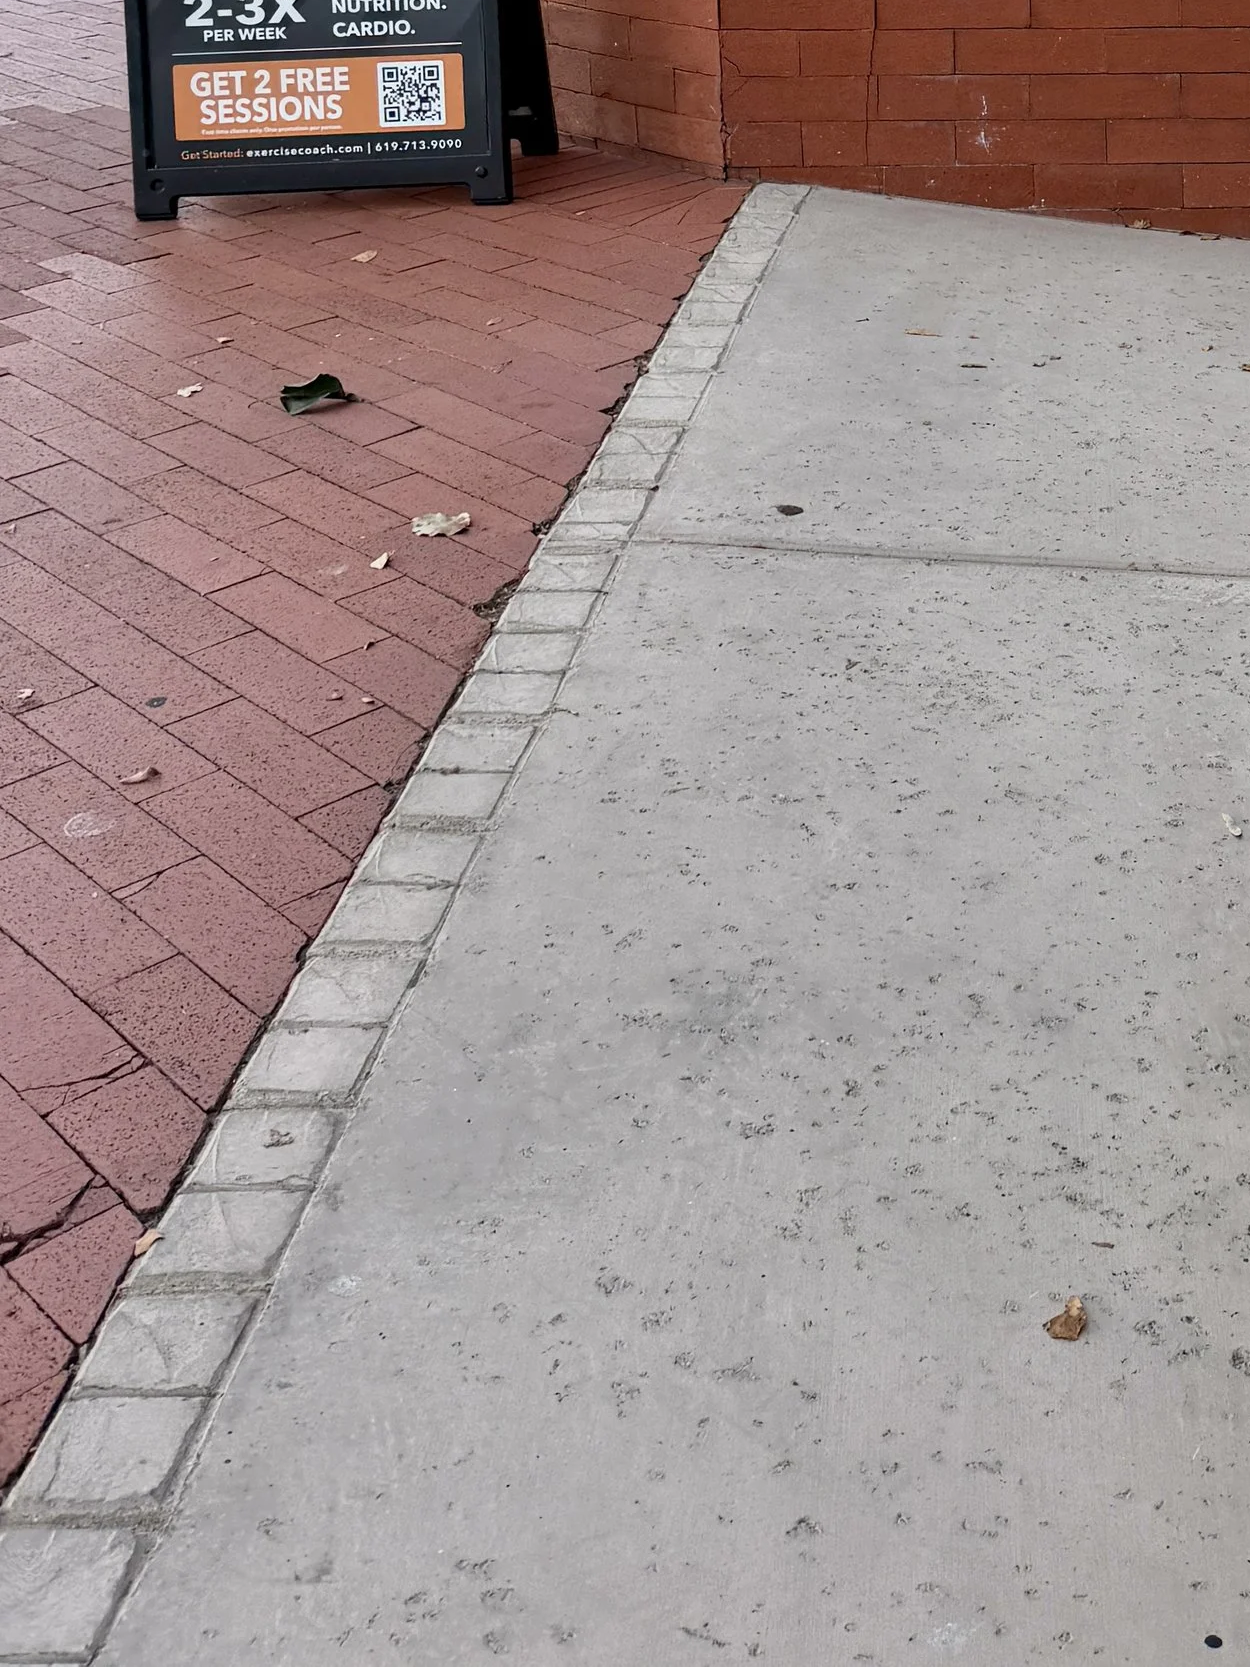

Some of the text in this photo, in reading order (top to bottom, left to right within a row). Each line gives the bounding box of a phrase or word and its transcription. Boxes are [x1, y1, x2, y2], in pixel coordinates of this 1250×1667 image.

[203, 27, 287, 42] PER WEEK
[332, 20, 416, 37] CARDIO.
[190, 66, 350, 97] GET 2 FREE
[200, 94, 343, 125] SESSIONS
[181, 150, 200, 160] Get
[202, 148, 244, 160] Started:
[246, 144, 363, 158] exercisecoach.com
[375, 139, 462, 152] 619.713.9090
